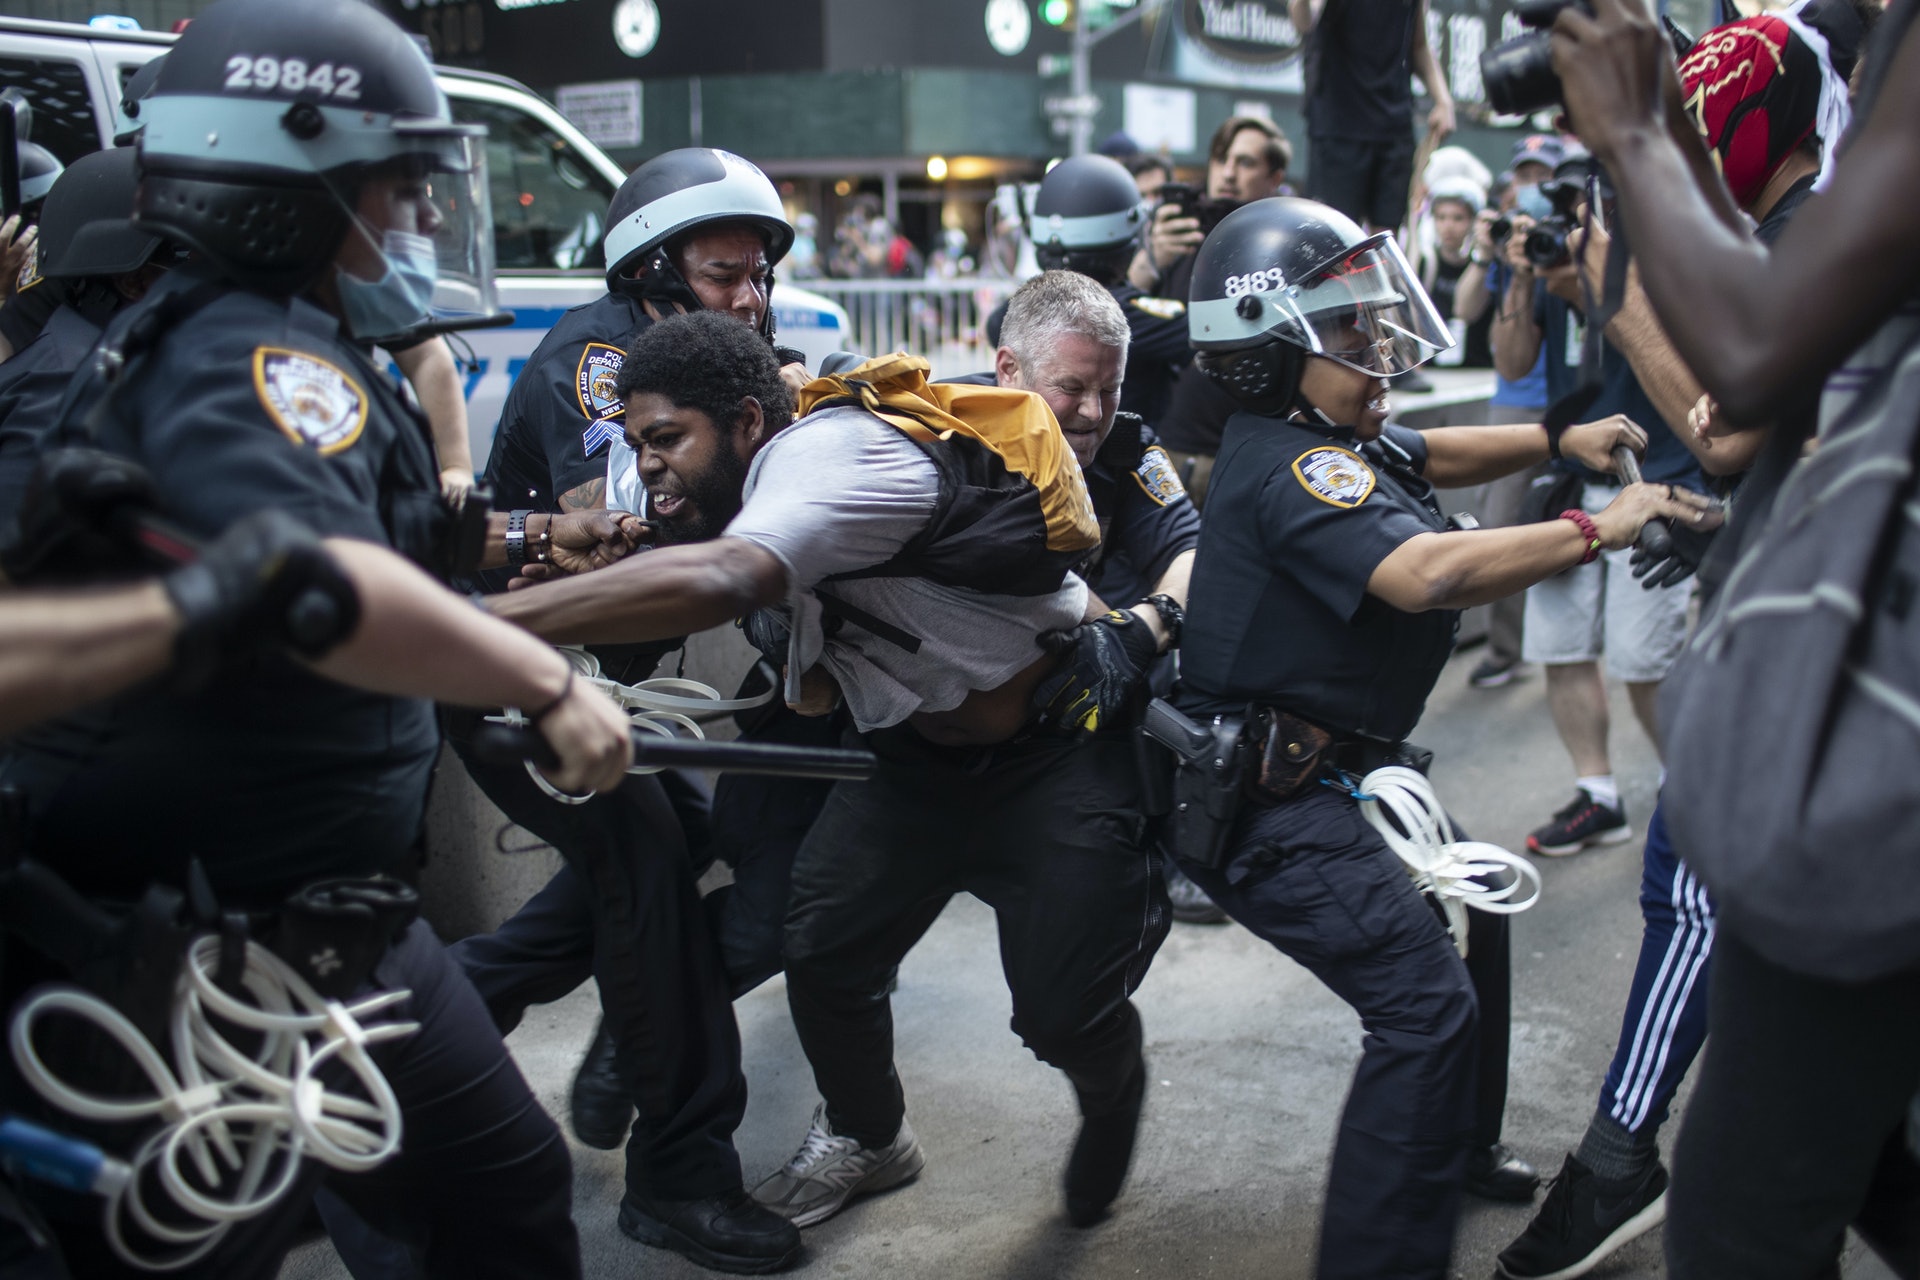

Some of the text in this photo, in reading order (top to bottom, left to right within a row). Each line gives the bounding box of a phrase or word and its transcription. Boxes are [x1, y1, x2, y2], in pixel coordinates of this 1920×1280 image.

[225, 56, 361, 99] 29842
[588, 356, 623, 370] DEPART
[604, 351, 623, 364] POL
[580, 371, 591, 406] CITY OF
[601, 404, 620, 417] NEW
